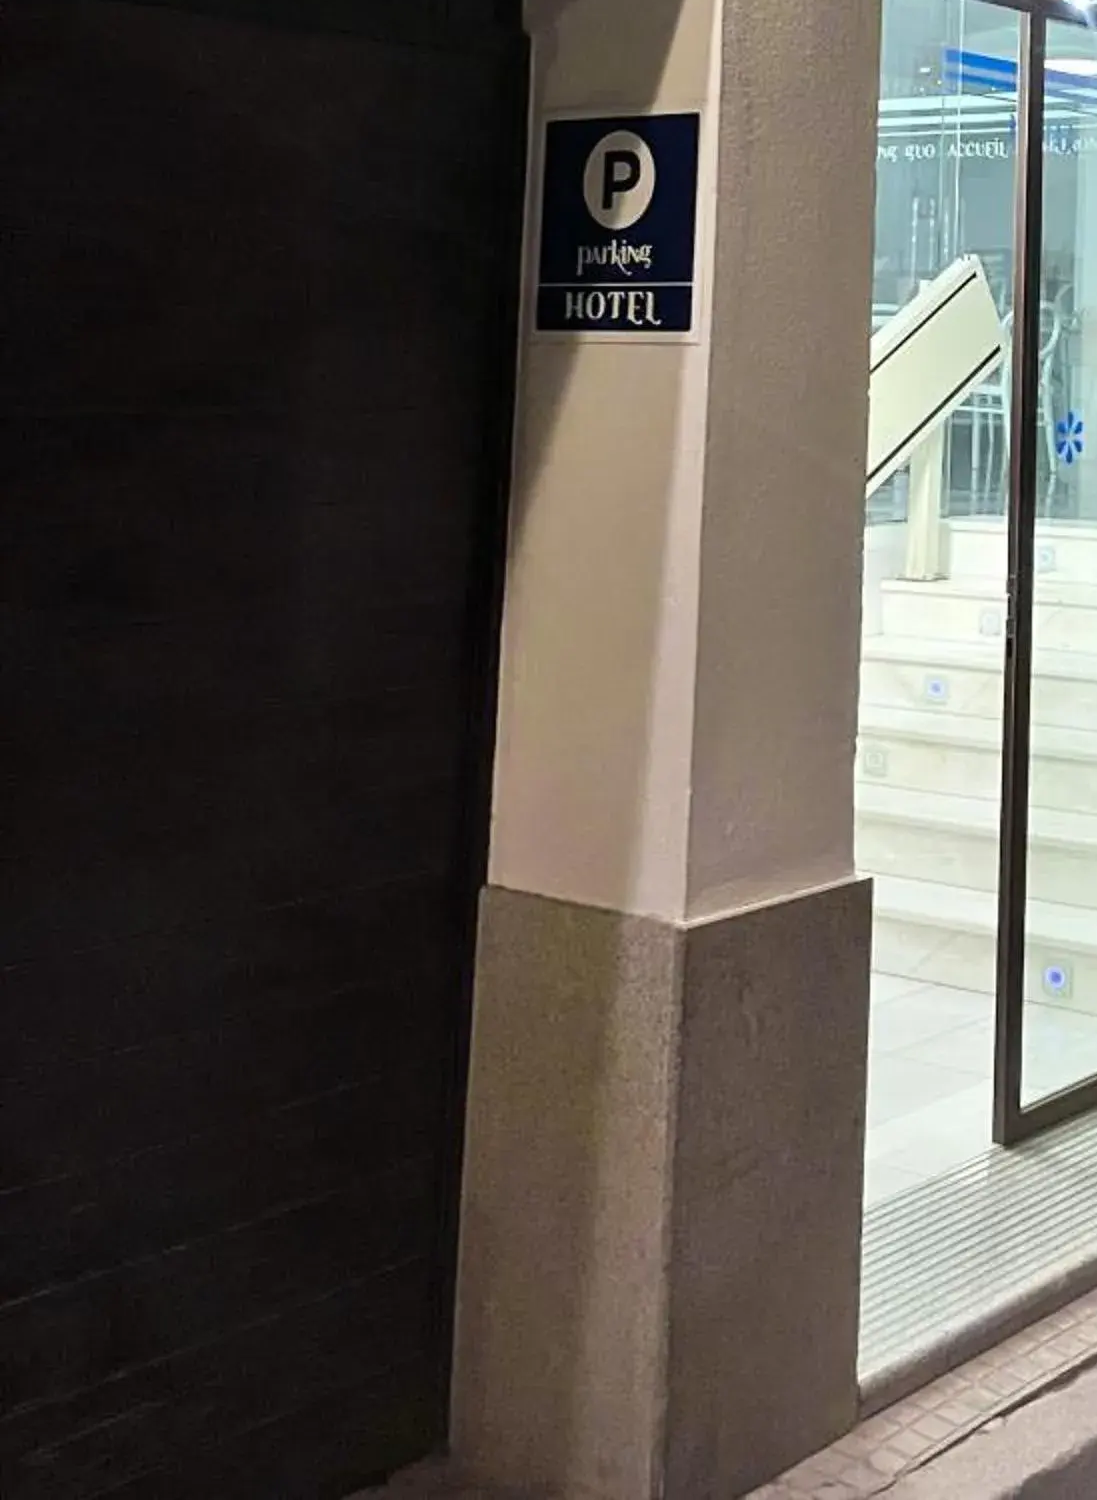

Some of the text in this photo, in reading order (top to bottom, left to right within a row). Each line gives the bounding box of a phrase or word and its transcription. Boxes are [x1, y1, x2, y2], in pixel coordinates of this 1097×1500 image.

[602, 150, 641, 210] P
[576, 239, 653, 276] parking
[564, 291, 662, 325] HOTEL
